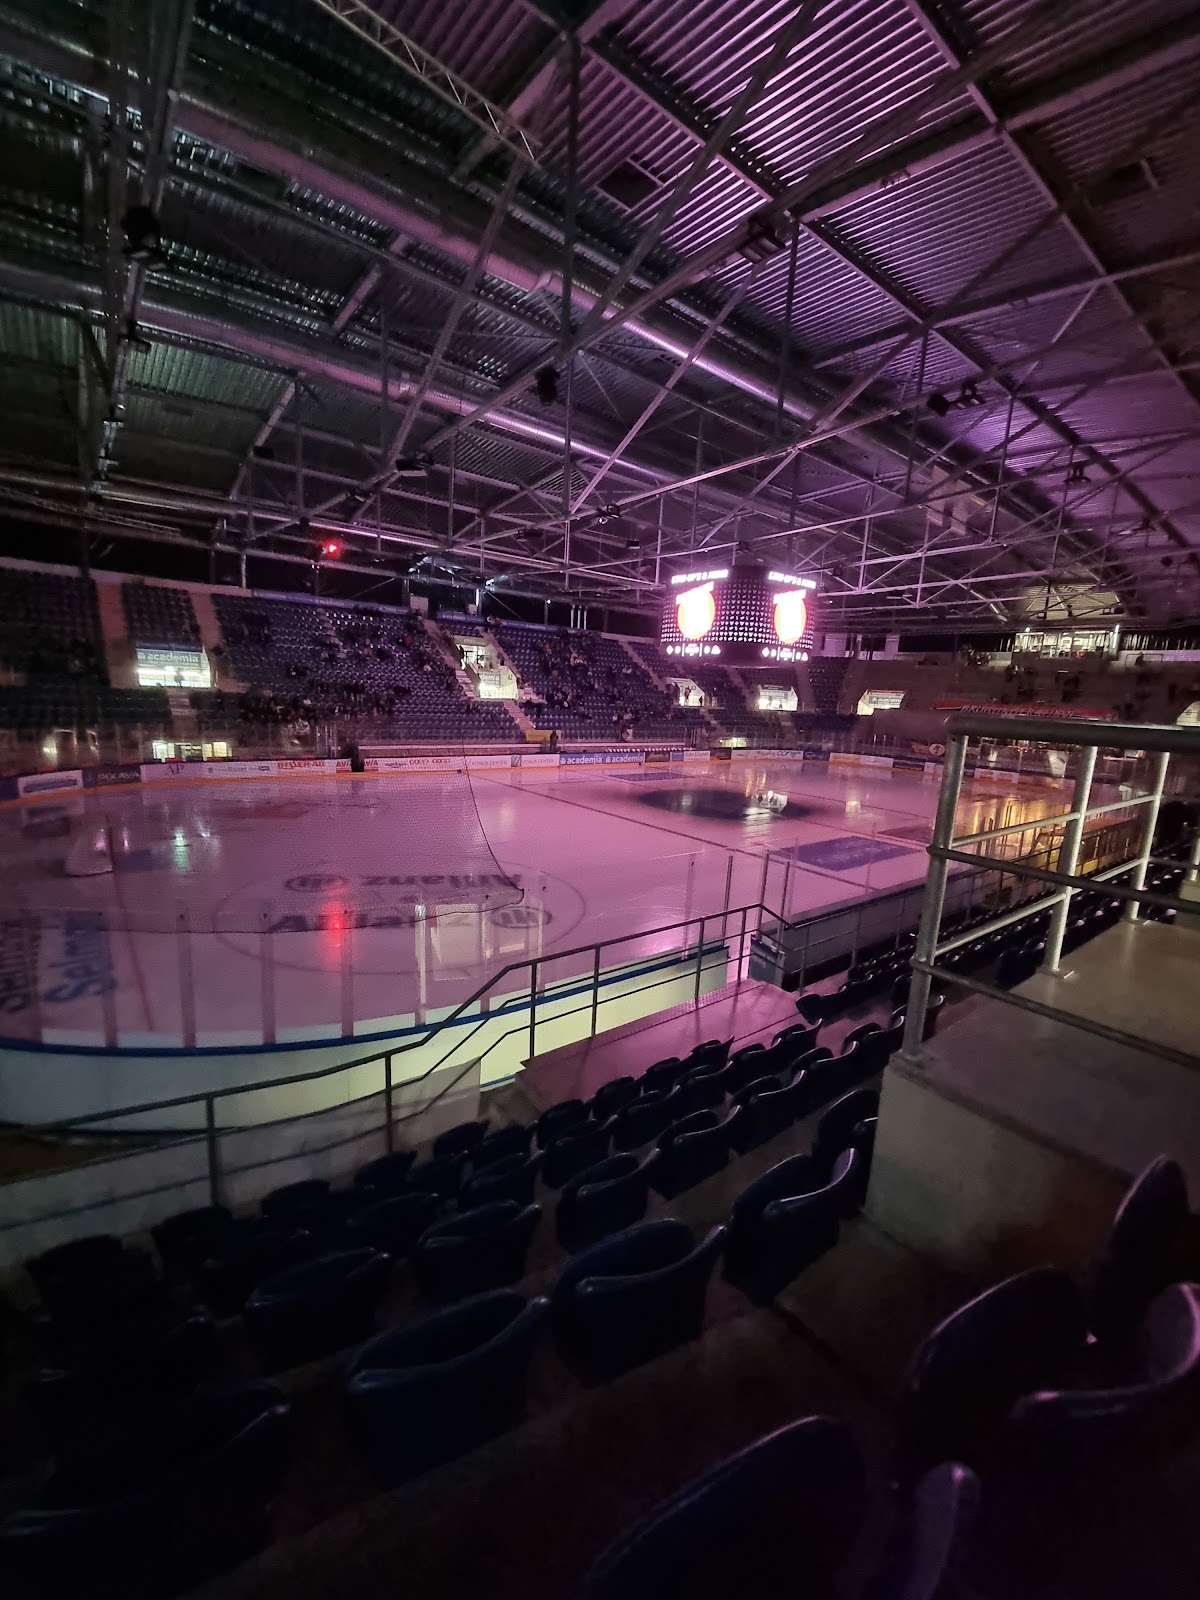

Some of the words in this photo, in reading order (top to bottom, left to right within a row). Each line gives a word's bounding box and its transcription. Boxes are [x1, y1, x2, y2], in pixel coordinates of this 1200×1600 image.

[147, 652, 199, 663] academia
[567, 755, 602, 764] academia
[612, 753, 644, 763] academia
